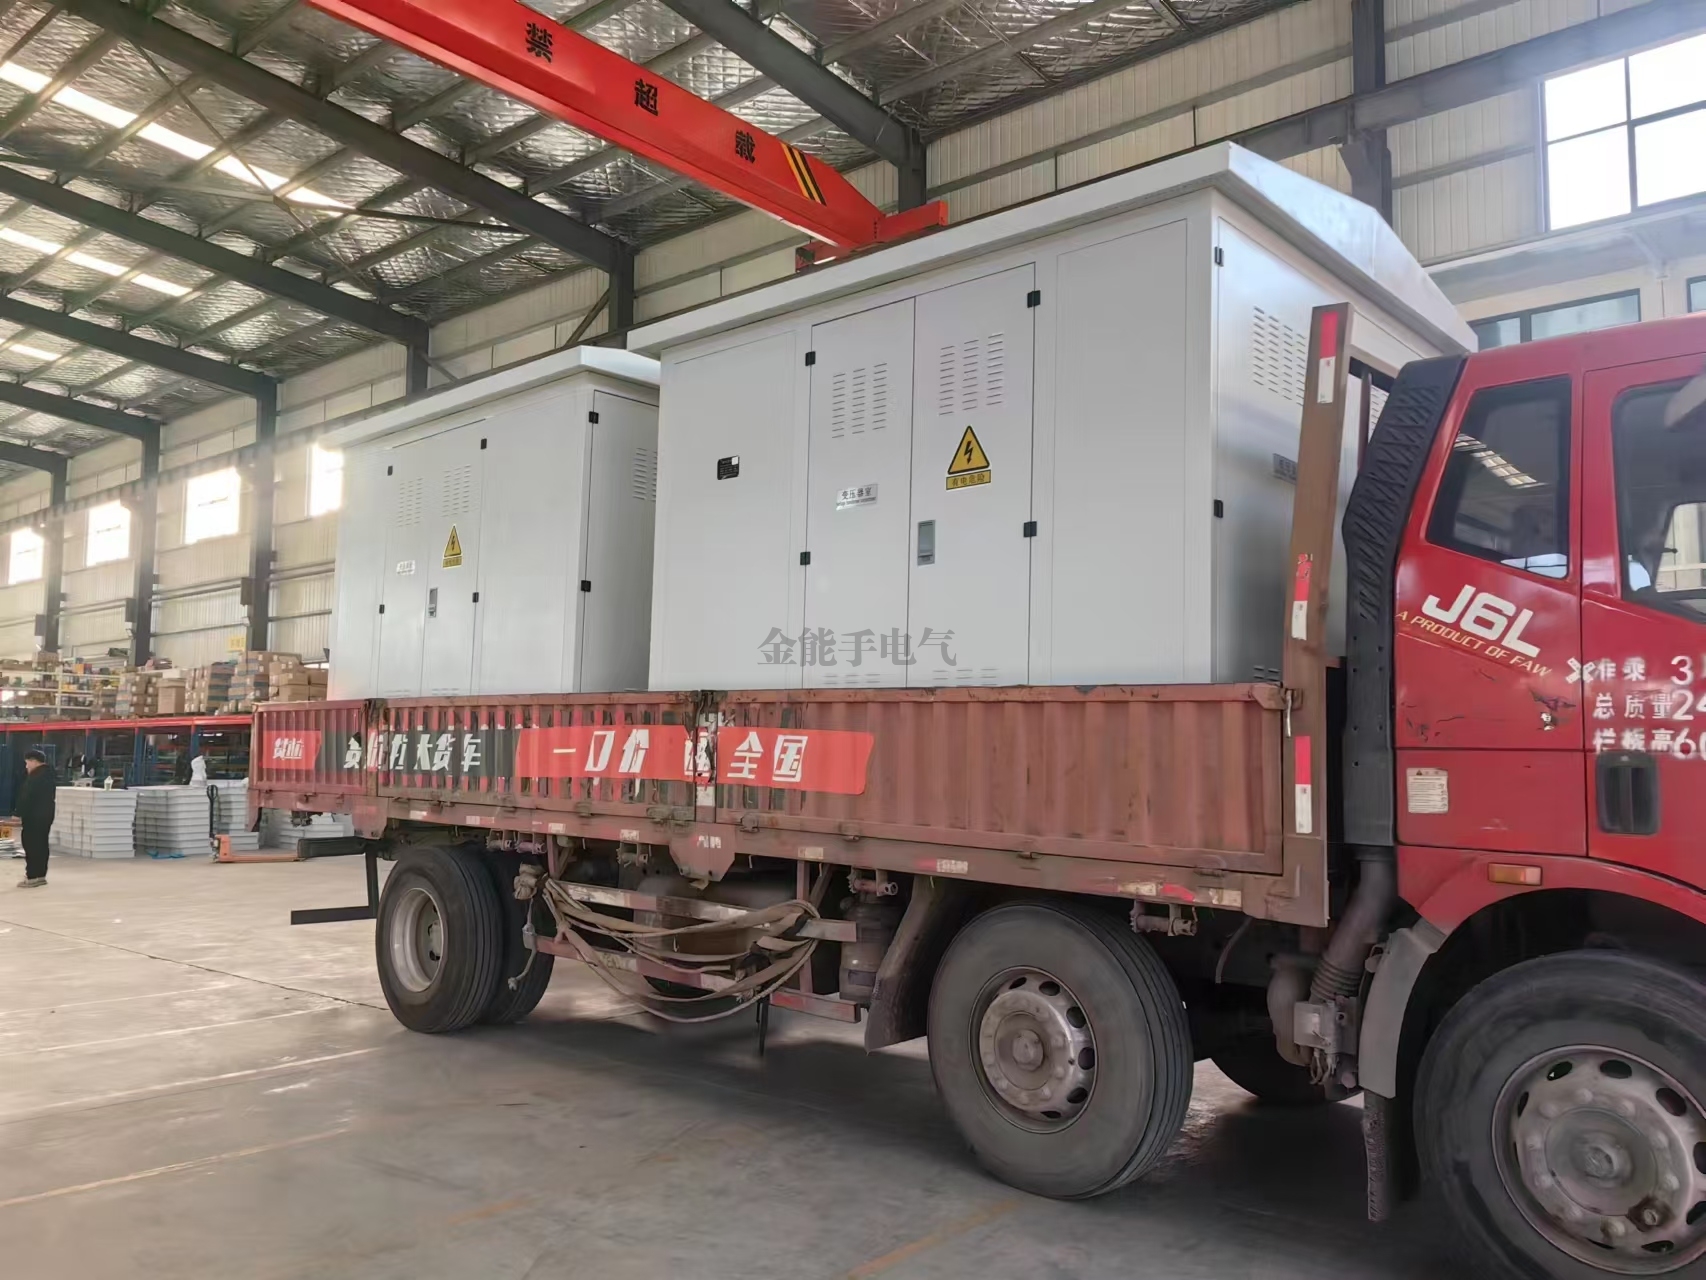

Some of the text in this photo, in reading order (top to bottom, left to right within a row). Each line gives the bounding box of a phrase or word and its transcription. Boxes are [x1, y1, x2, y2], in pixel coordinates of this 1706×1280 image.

[1395, 610, 1552, 677] A PRODUCT OF FAW
[1421, 584, 1541, 658] J6L
[553, 729, 649, 773] 一口价
